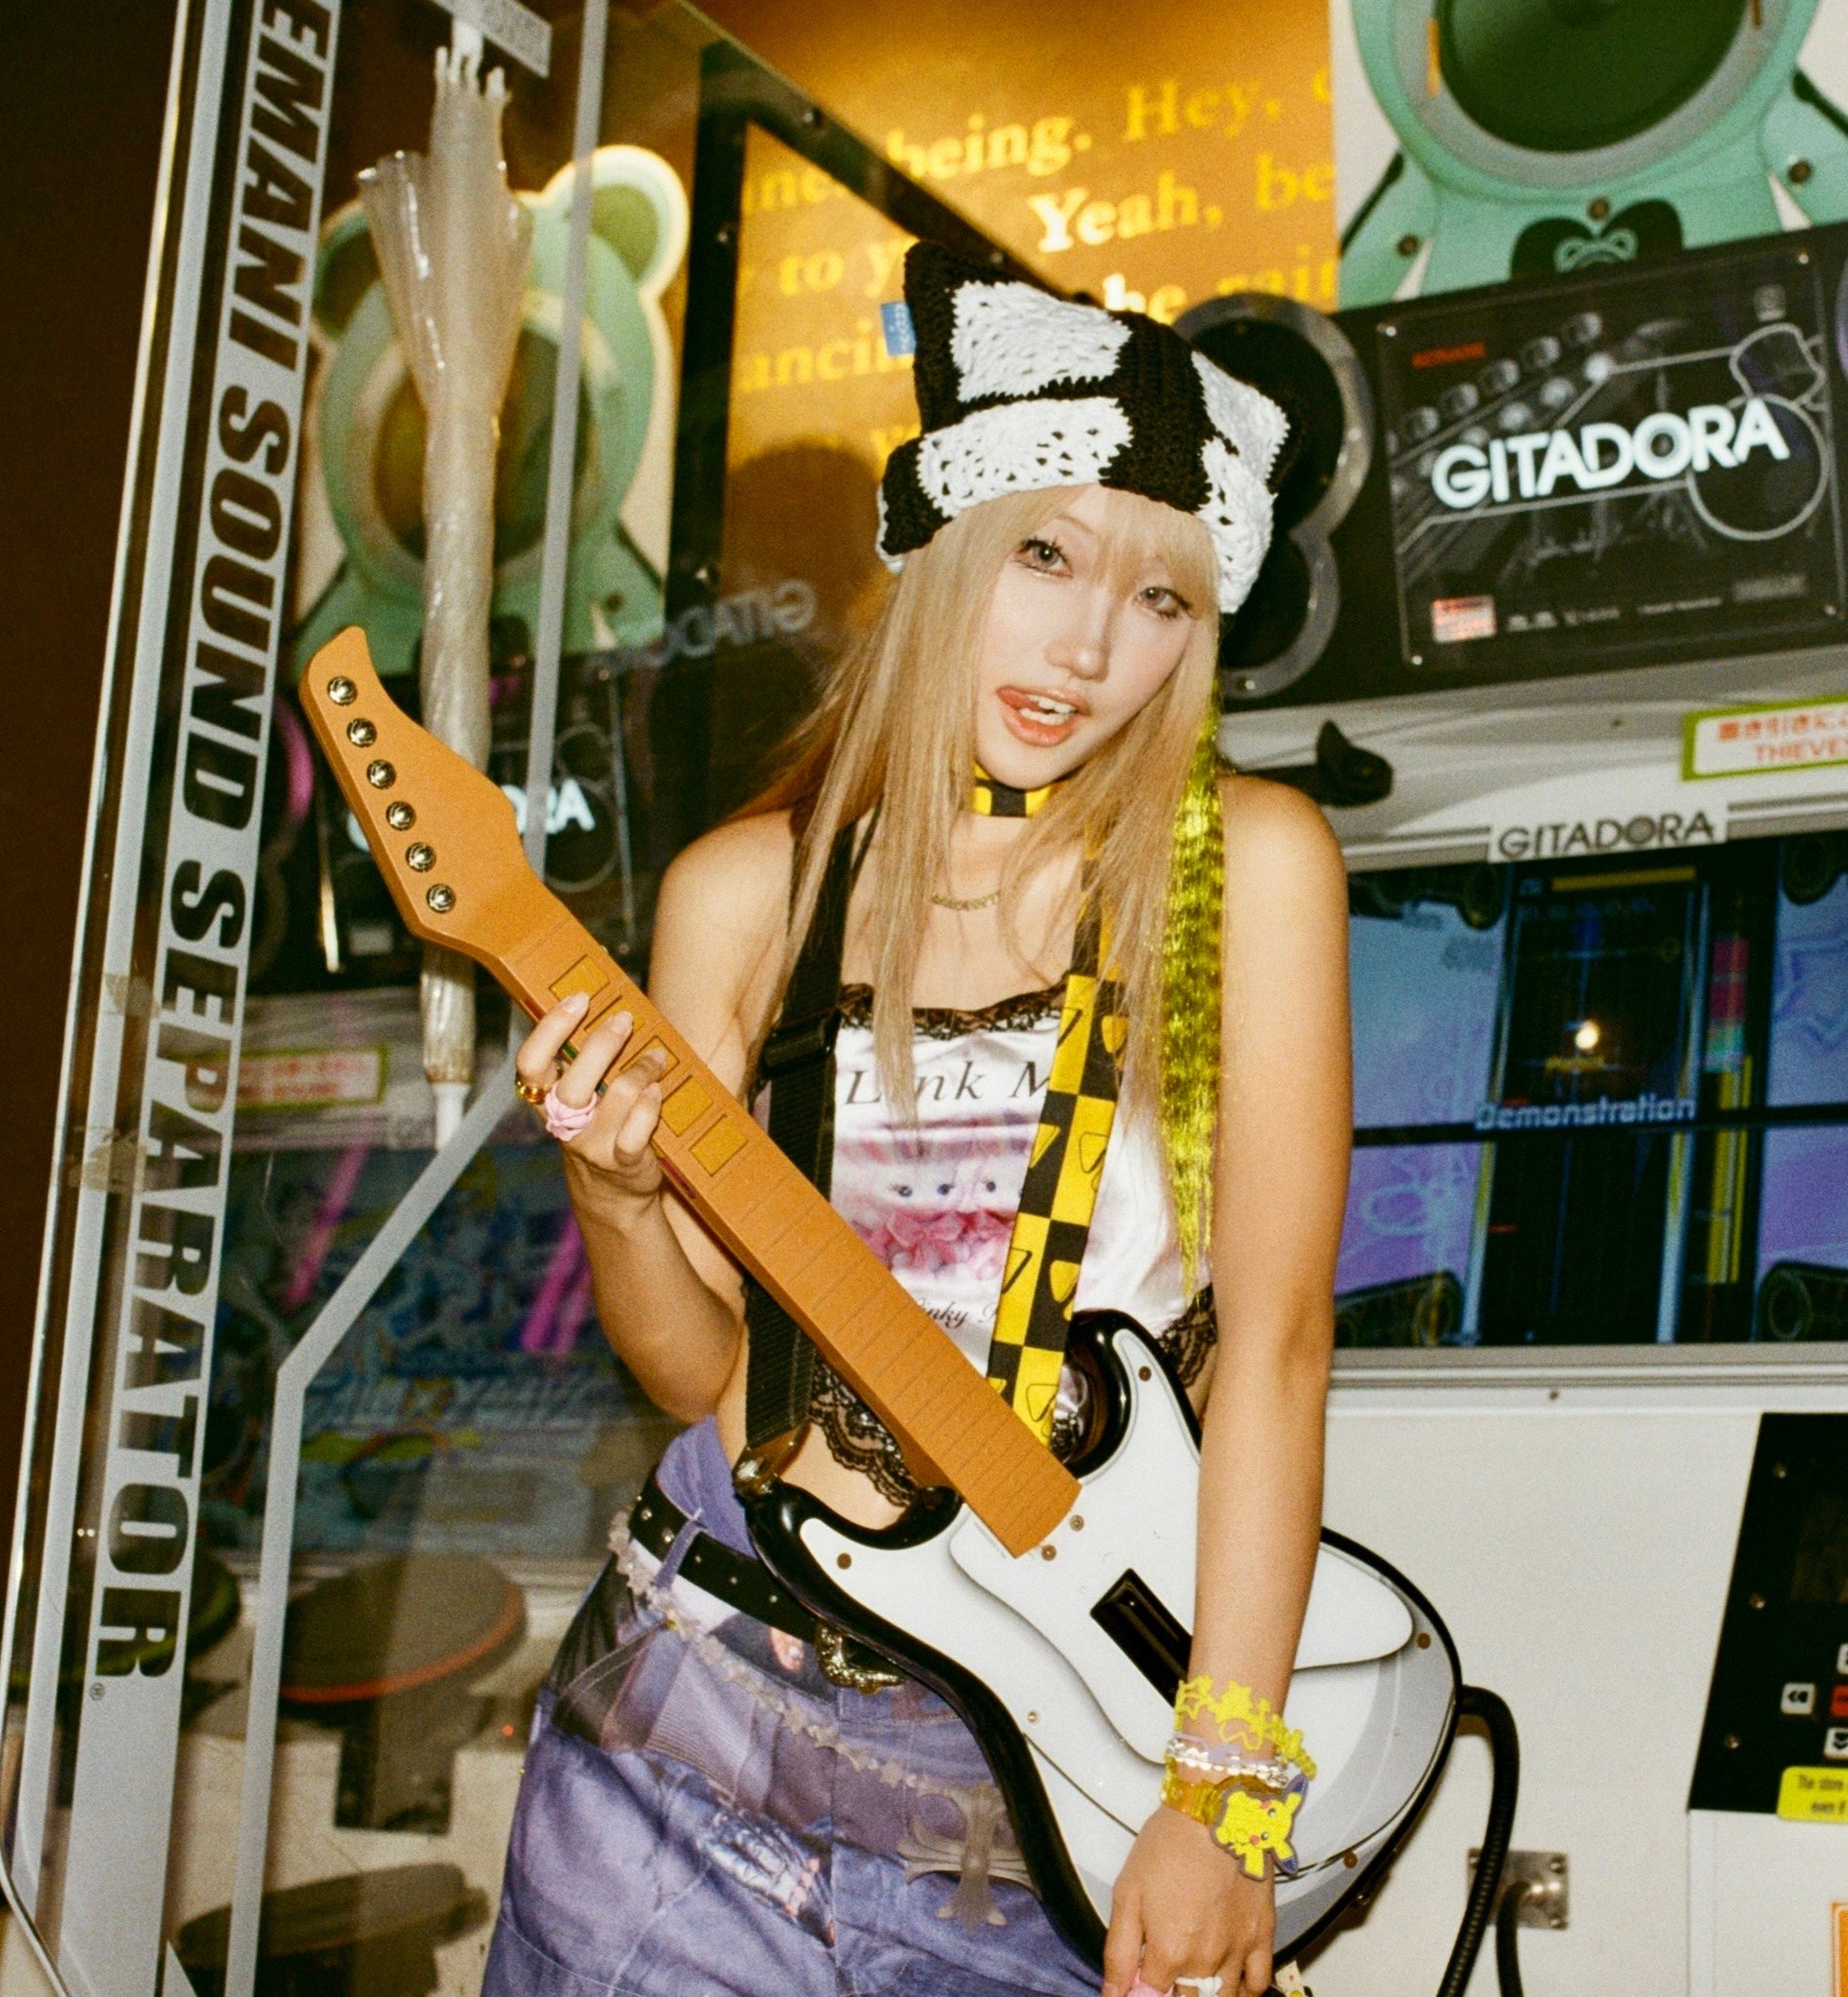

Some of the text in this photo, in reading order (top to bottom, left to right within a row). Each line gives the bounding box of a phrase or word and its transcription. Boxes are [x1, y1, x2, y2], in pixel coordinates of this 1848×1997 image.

[1027, 169, 1224, 254] Yeah,
[1431, 397, 1791, 510] GITADORA
[182, 384, 292, 831] SOUND
[1498, 811, 1716, 861] GITADORA
[844, 1060, 989, 1105] Lnk
[1473, 1093, 1699, 1132] Demonstration
[95, 859, 246, 1678] SEPARATOR
